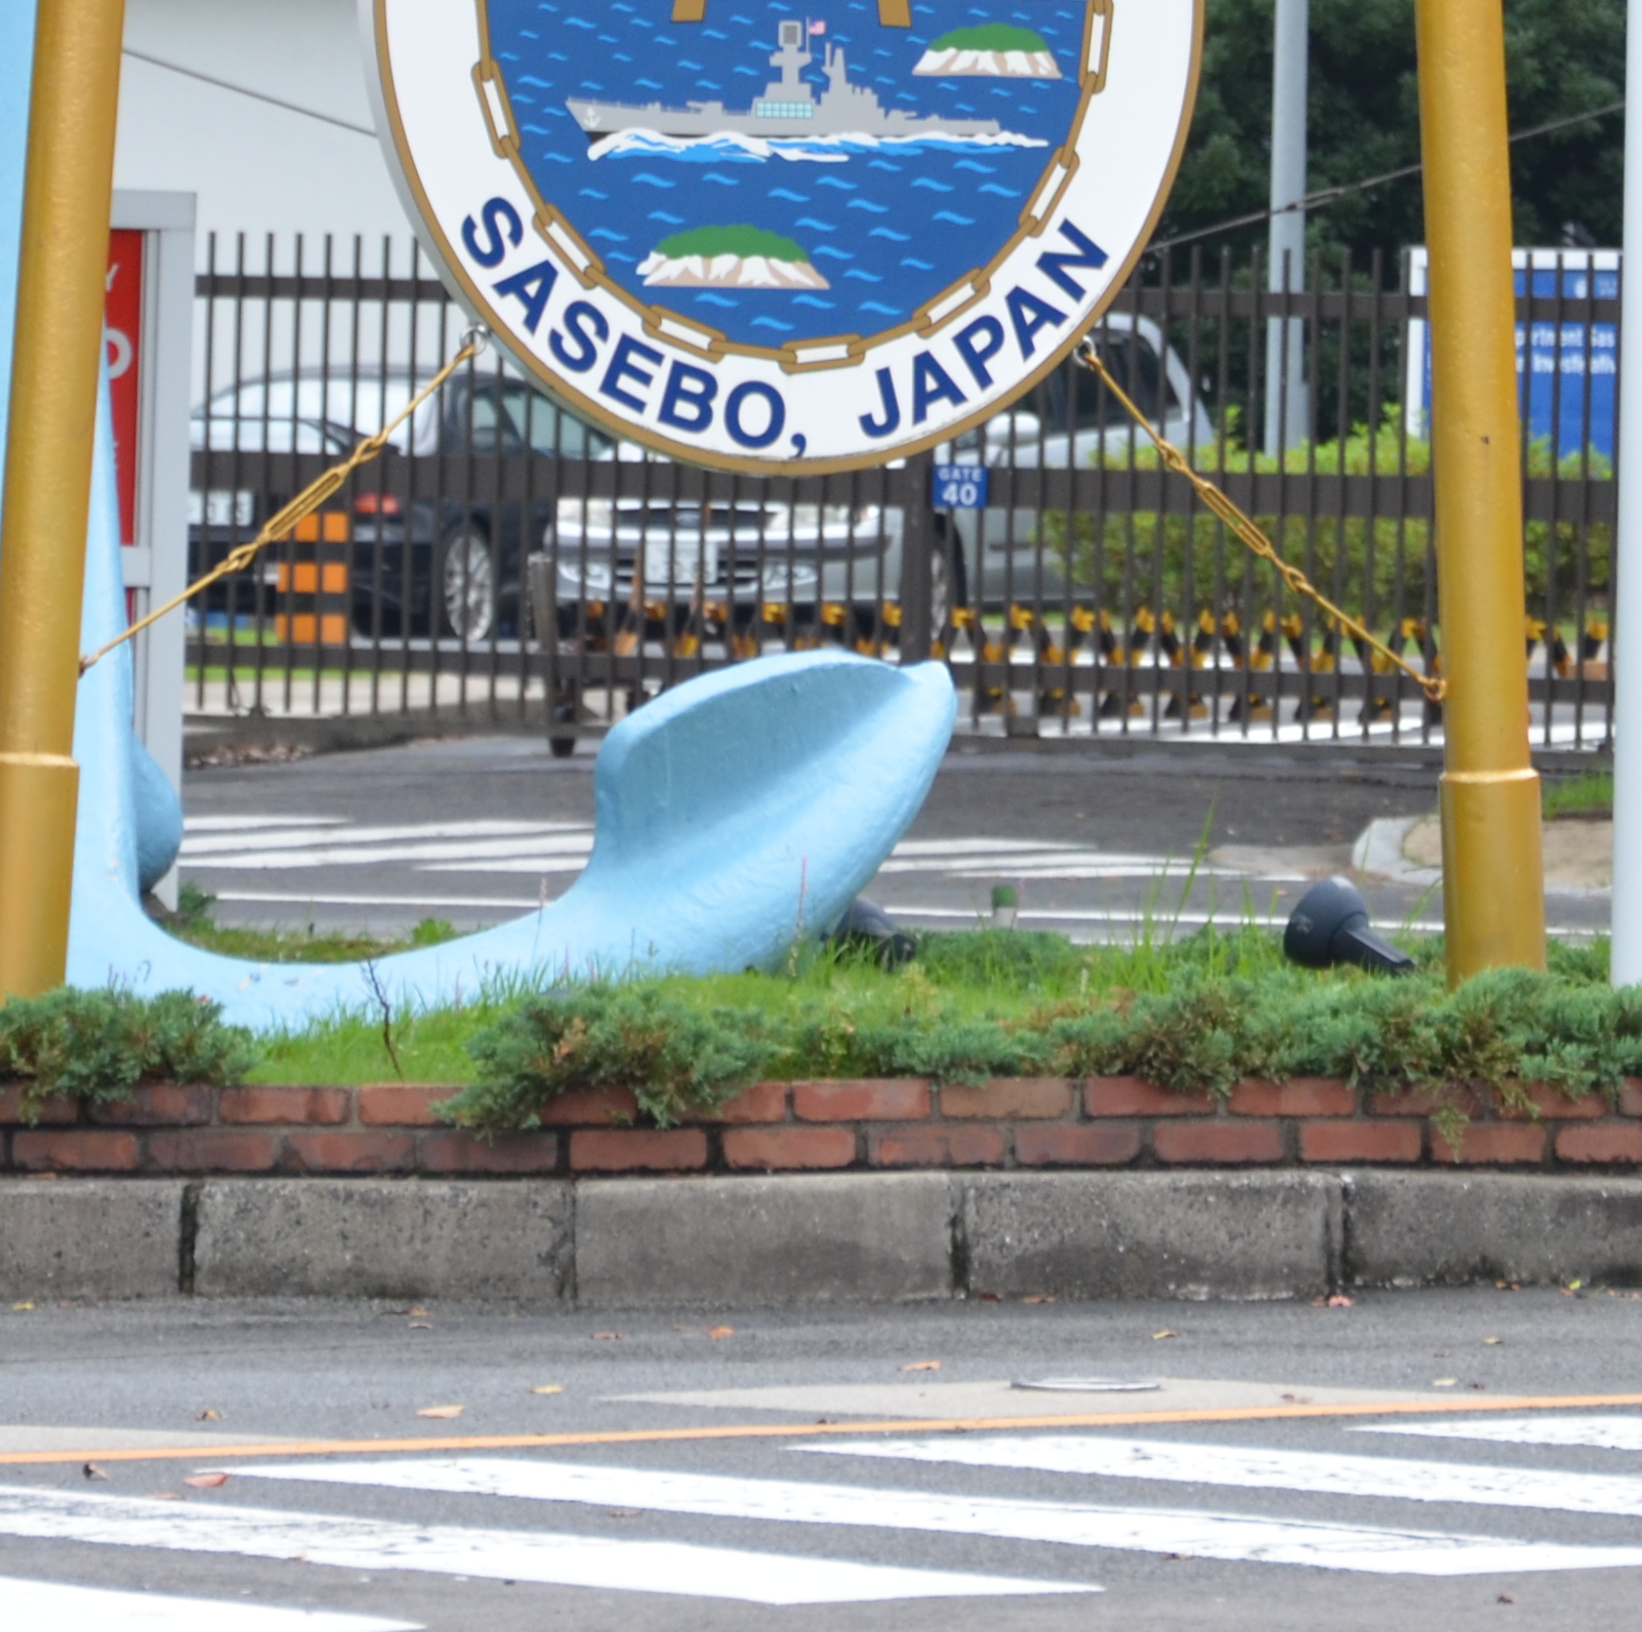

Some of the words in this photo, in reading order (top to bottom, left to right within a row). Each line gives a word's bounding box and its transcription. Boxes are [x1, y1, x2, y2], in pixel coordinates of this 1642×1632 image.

[462, 196, 808, 461] SASEBO,
[858, 221, 1110, 439] JAPAN
[938, 466, 982, 483] GATE
[941, 482, 978, 506] 40
